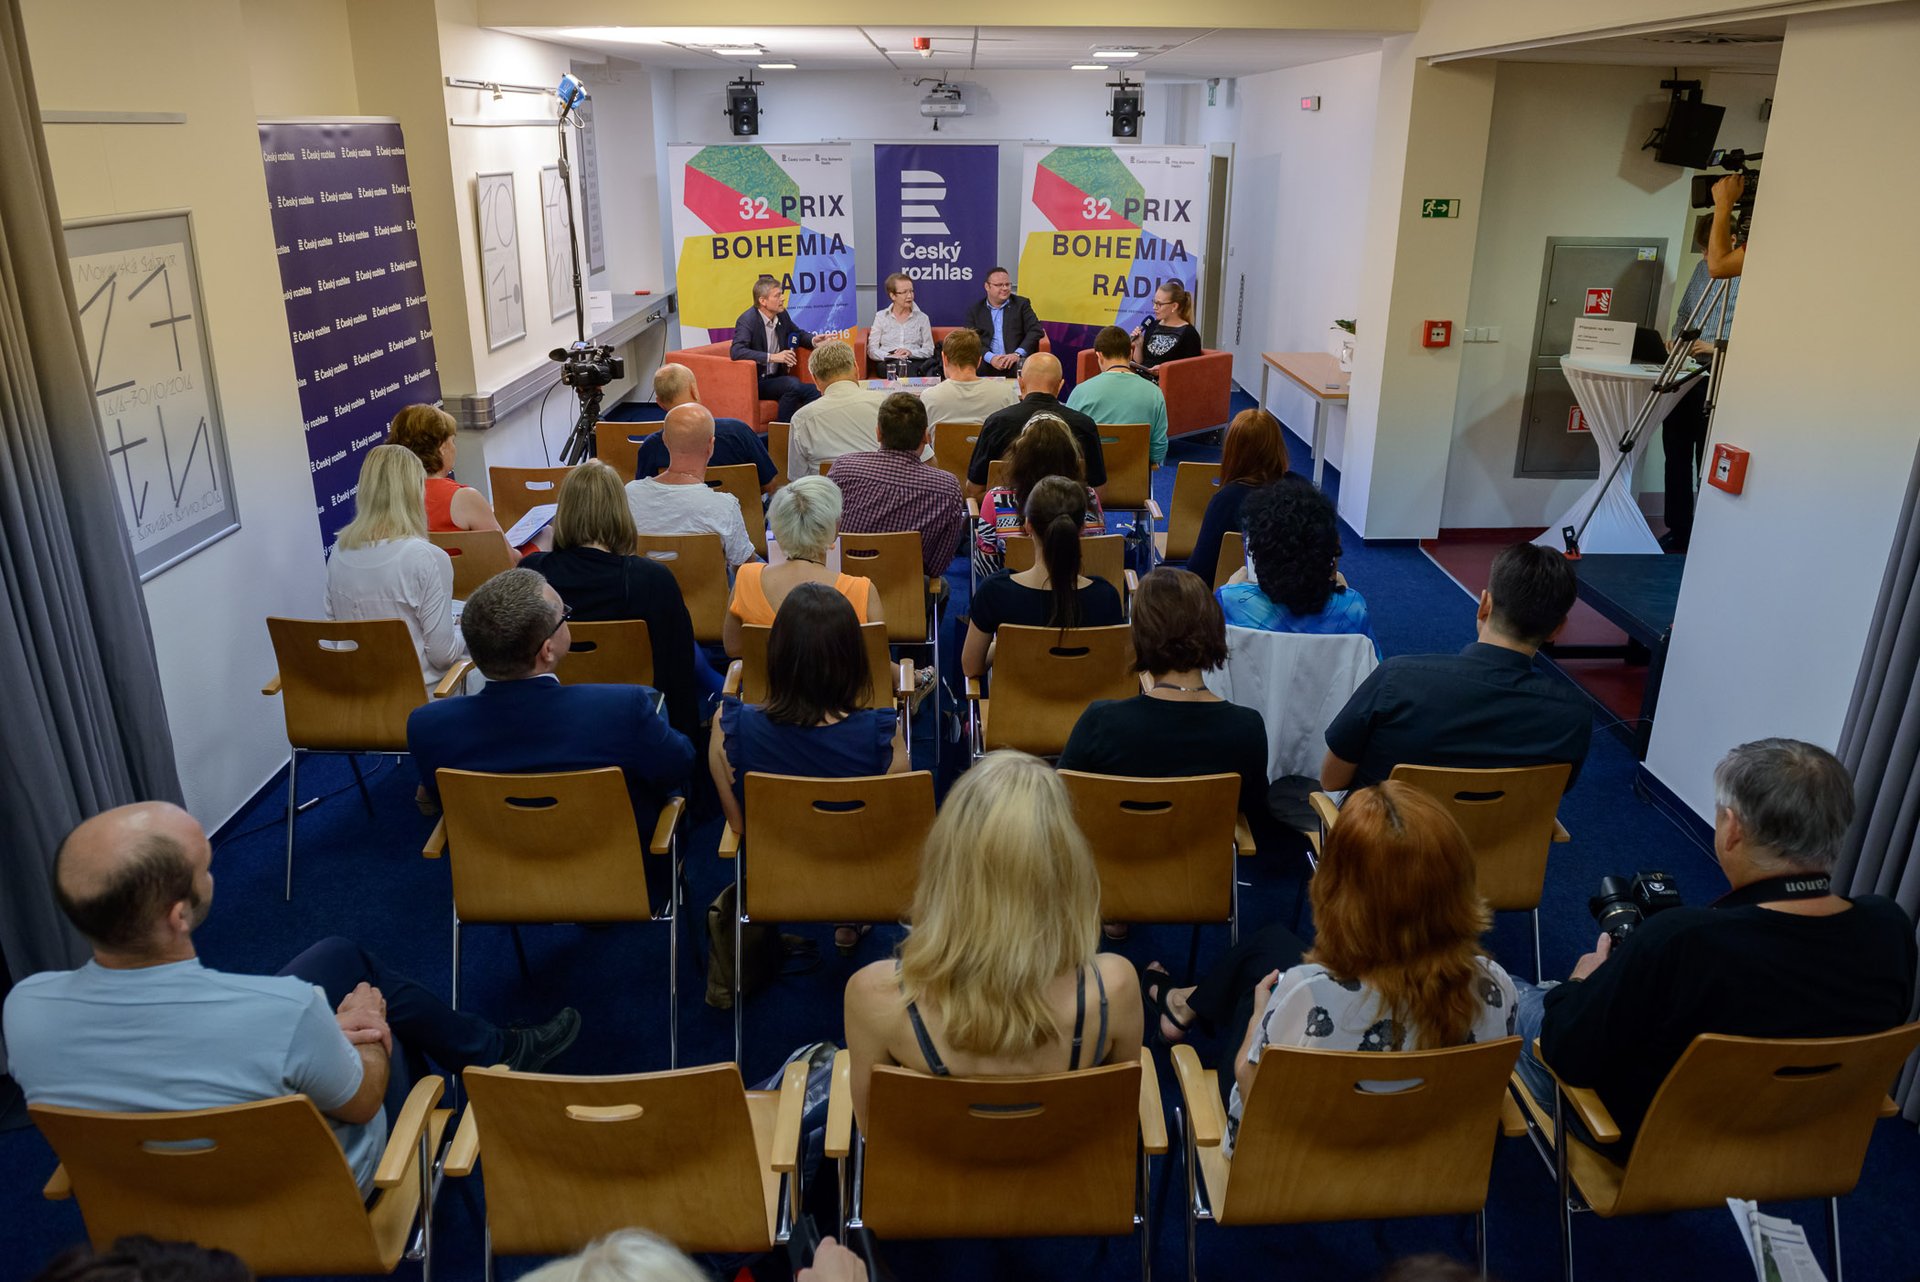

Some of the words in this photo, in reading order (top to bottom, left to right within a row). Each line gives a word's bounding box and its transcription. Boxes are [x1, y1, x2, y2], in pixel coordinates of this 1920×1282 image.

[739, 196, 769, 220] 32
[781, 194, 845, 218] PRIX
[1082, 197, 1112, 220] 32
[1124, 198, 1192, 222] PRIX
[712, 233, 847, 260] BOHEMIA
[900, 238, 961, 262] Český
[1053, 234, 1188, 262] BOHEMIA
[759, 270, 847, 294] ADIO
[902, 263, 972, 280] rozhlas
[1785, 878, 1829, 892] Canon
